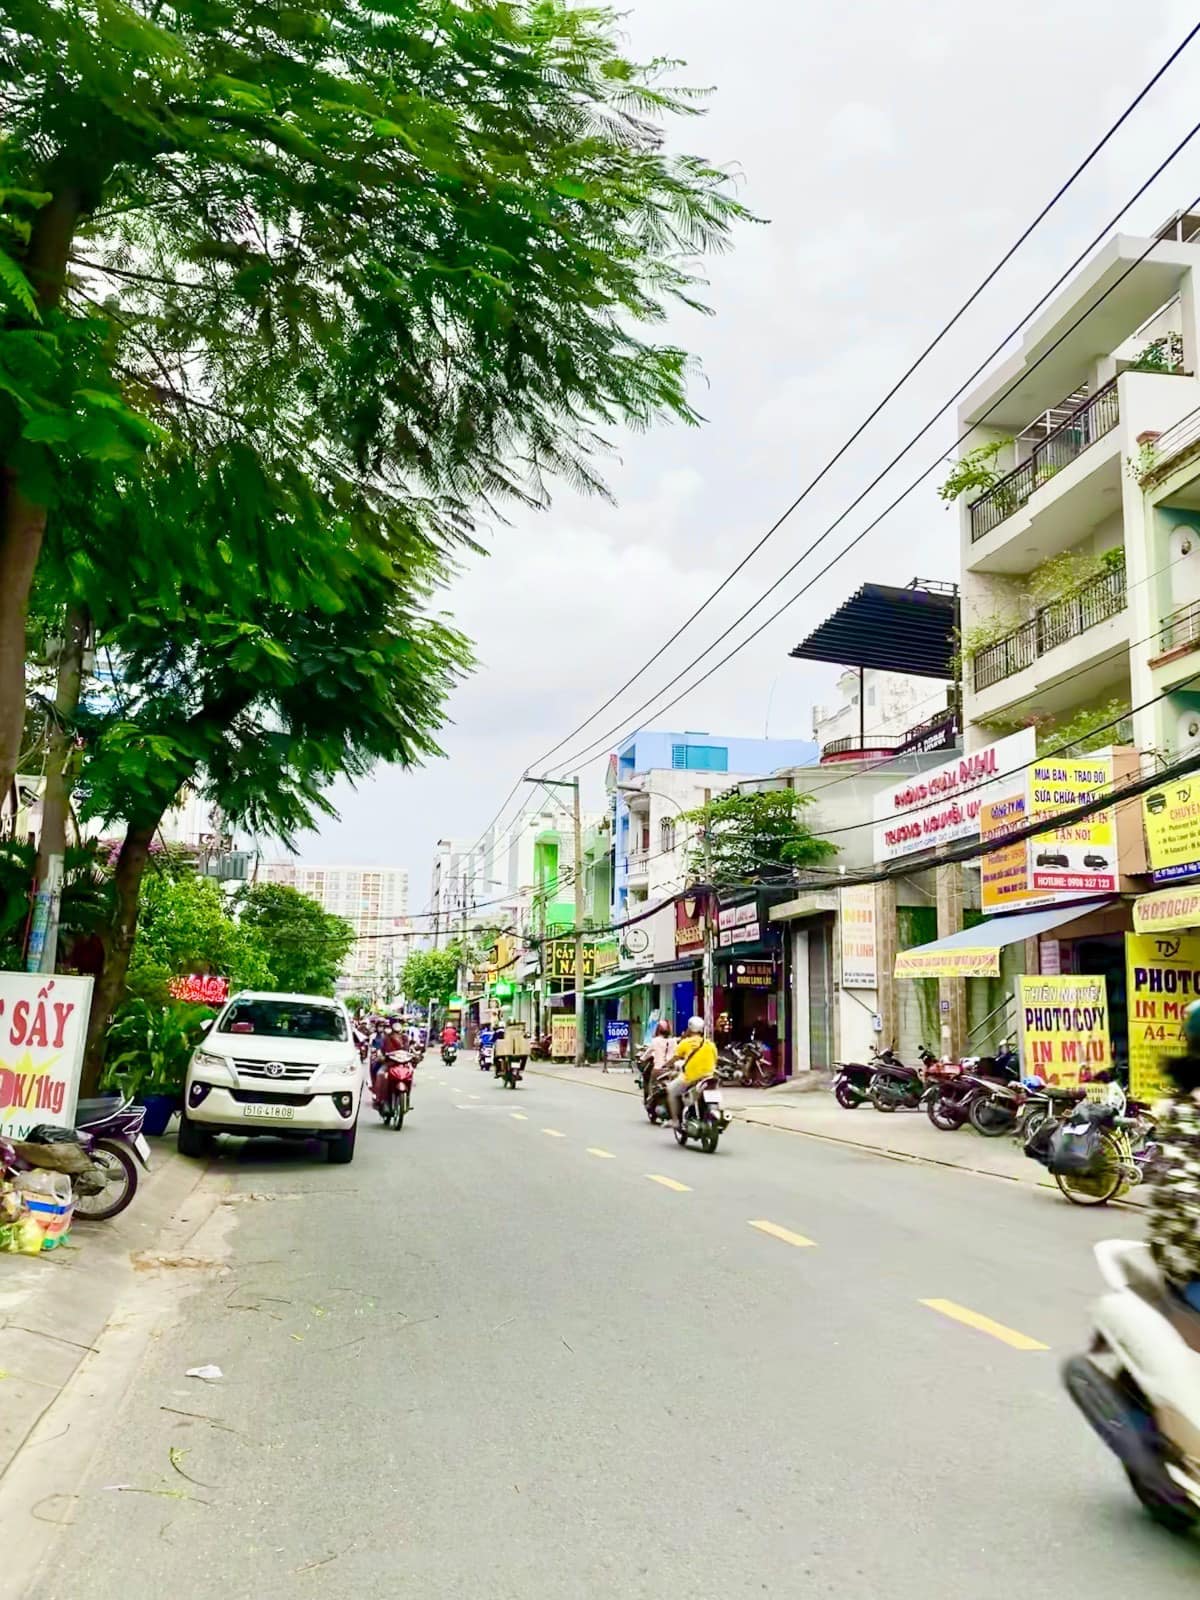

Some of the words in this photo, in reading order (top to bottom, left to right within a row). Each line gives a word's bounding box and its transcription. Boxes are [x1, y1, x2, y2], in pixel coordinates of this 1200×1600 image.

[1035, 768, 1050, 780] MUA
[1074, 770, 1092, 783] TRAO
[1037, 876, 1067, 887] HOTLINE:
[9, 979, 75, 1048] SẤY
[1135, 1000, 1156, 1018] IN
[1032, 1041, 1053, 1063] IN
